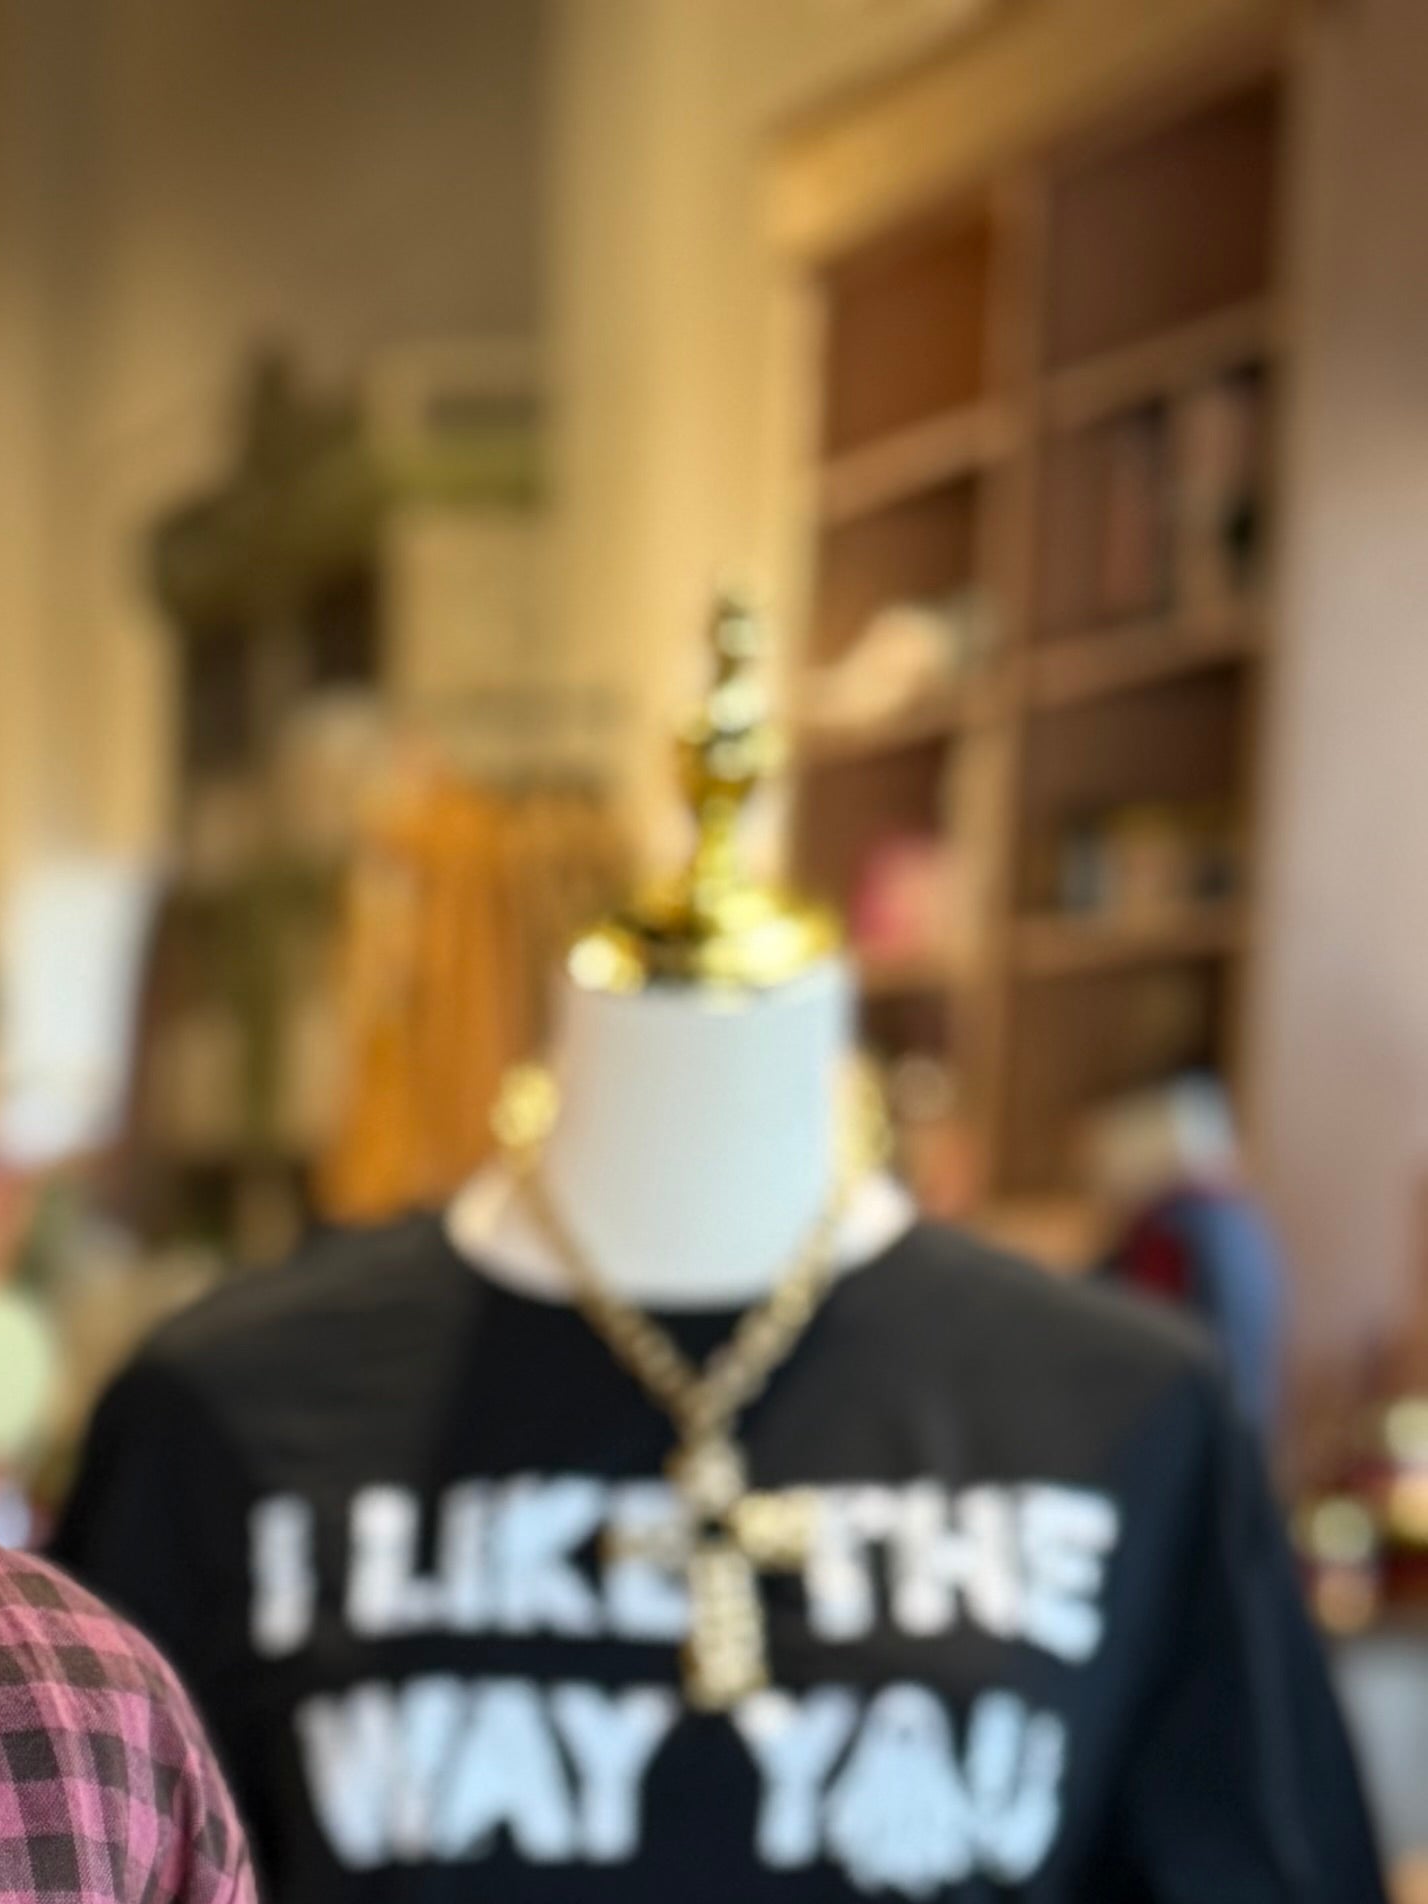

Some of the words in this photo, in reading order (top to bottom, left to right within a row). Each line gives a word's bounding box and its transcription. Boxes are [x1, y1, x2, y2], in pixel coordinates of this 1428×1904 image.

[248, 1491, 315, 1658] I
[345, 1472, 693, 1640] LIKE
[804, 1478, 1121, 1660] THE
[297, 1673, 674, 1869] WAY
